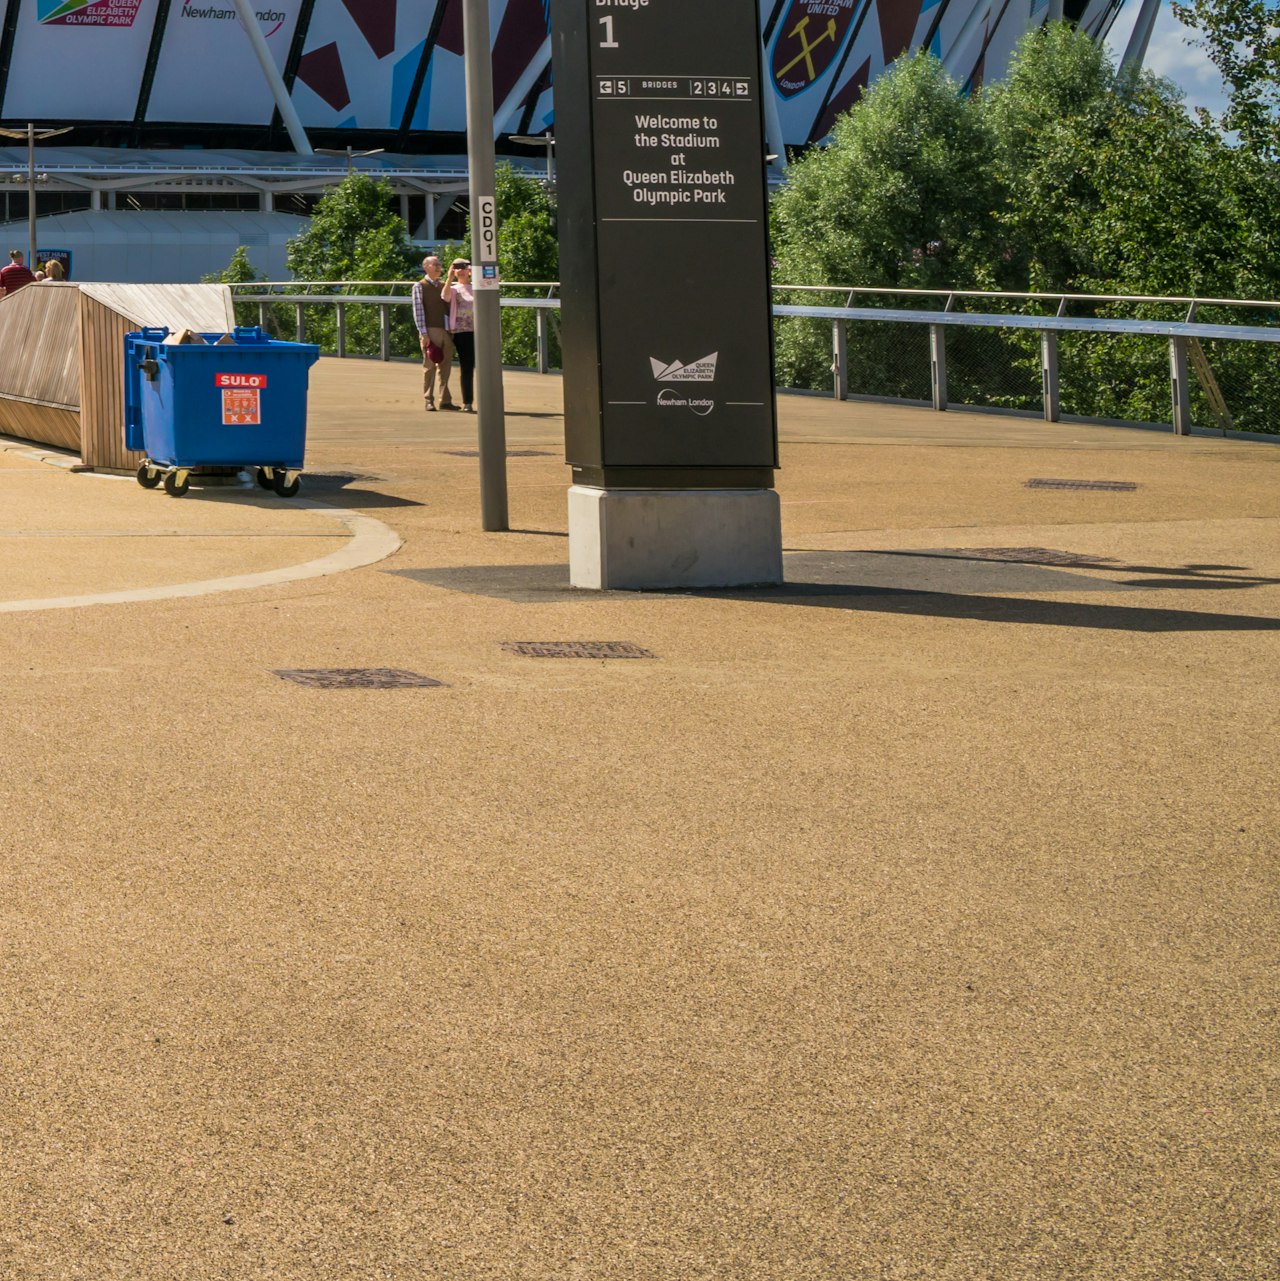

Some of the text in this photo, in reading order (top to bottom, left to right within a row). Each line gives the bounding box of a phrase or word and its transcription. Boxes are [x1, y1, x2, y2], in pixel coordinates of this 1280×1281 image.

[86, 7, 136, 16] ELIZABETH
[181, 5, 286, 21] Newham ndon
[806, 4, 840, 15] UNITED
[65, 15, 133, 24] OLYMPIC PARK
[598, 15, 619, 48] 1
[617, 81, 731, 95] 5 BRIDGES 2 3 4
[780, 78, 805, 89] LONDON
[635, 114, 718, 129] Welcome to
[634, 133, 720, 148] the Stadium
[670, 152, 686, 165] at
[623, 170, 735, 186] Queen Elizabeth
[633, 188, 726, 206] Olympic Park
[220, 375, 260, 387] SULO
[657, 398, 714, 406] Newham London
